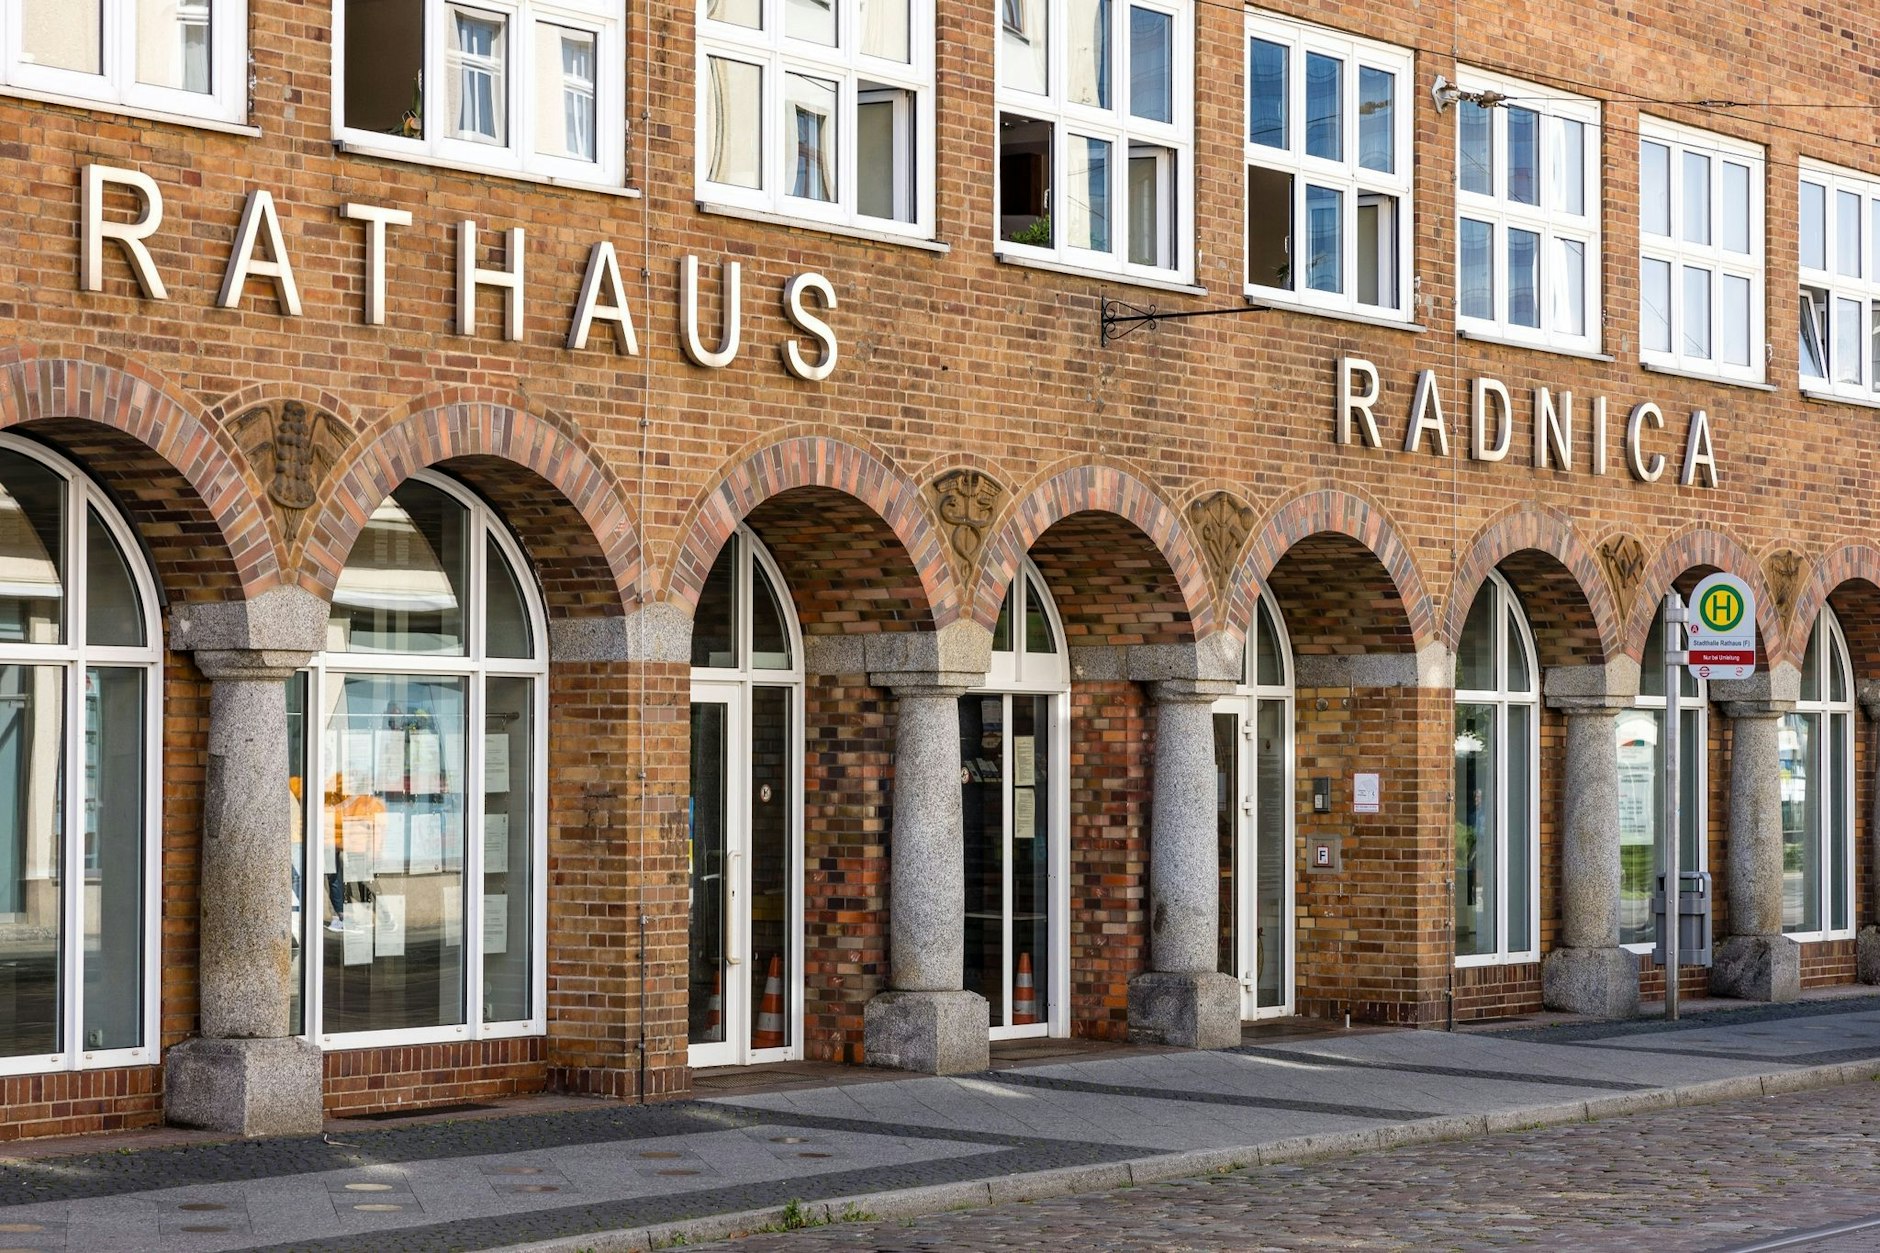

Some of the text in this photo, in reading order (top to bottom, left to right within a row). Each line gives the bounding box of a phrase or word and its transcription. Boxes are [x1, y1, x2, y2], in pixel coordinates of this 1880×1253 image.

[80, 163, 838, 382] RATHAUS
[1337, 356, 1719, 488] RADNICA
[1713, 595, 1730, 621] H
[1319, 850, 1326, 861] F
